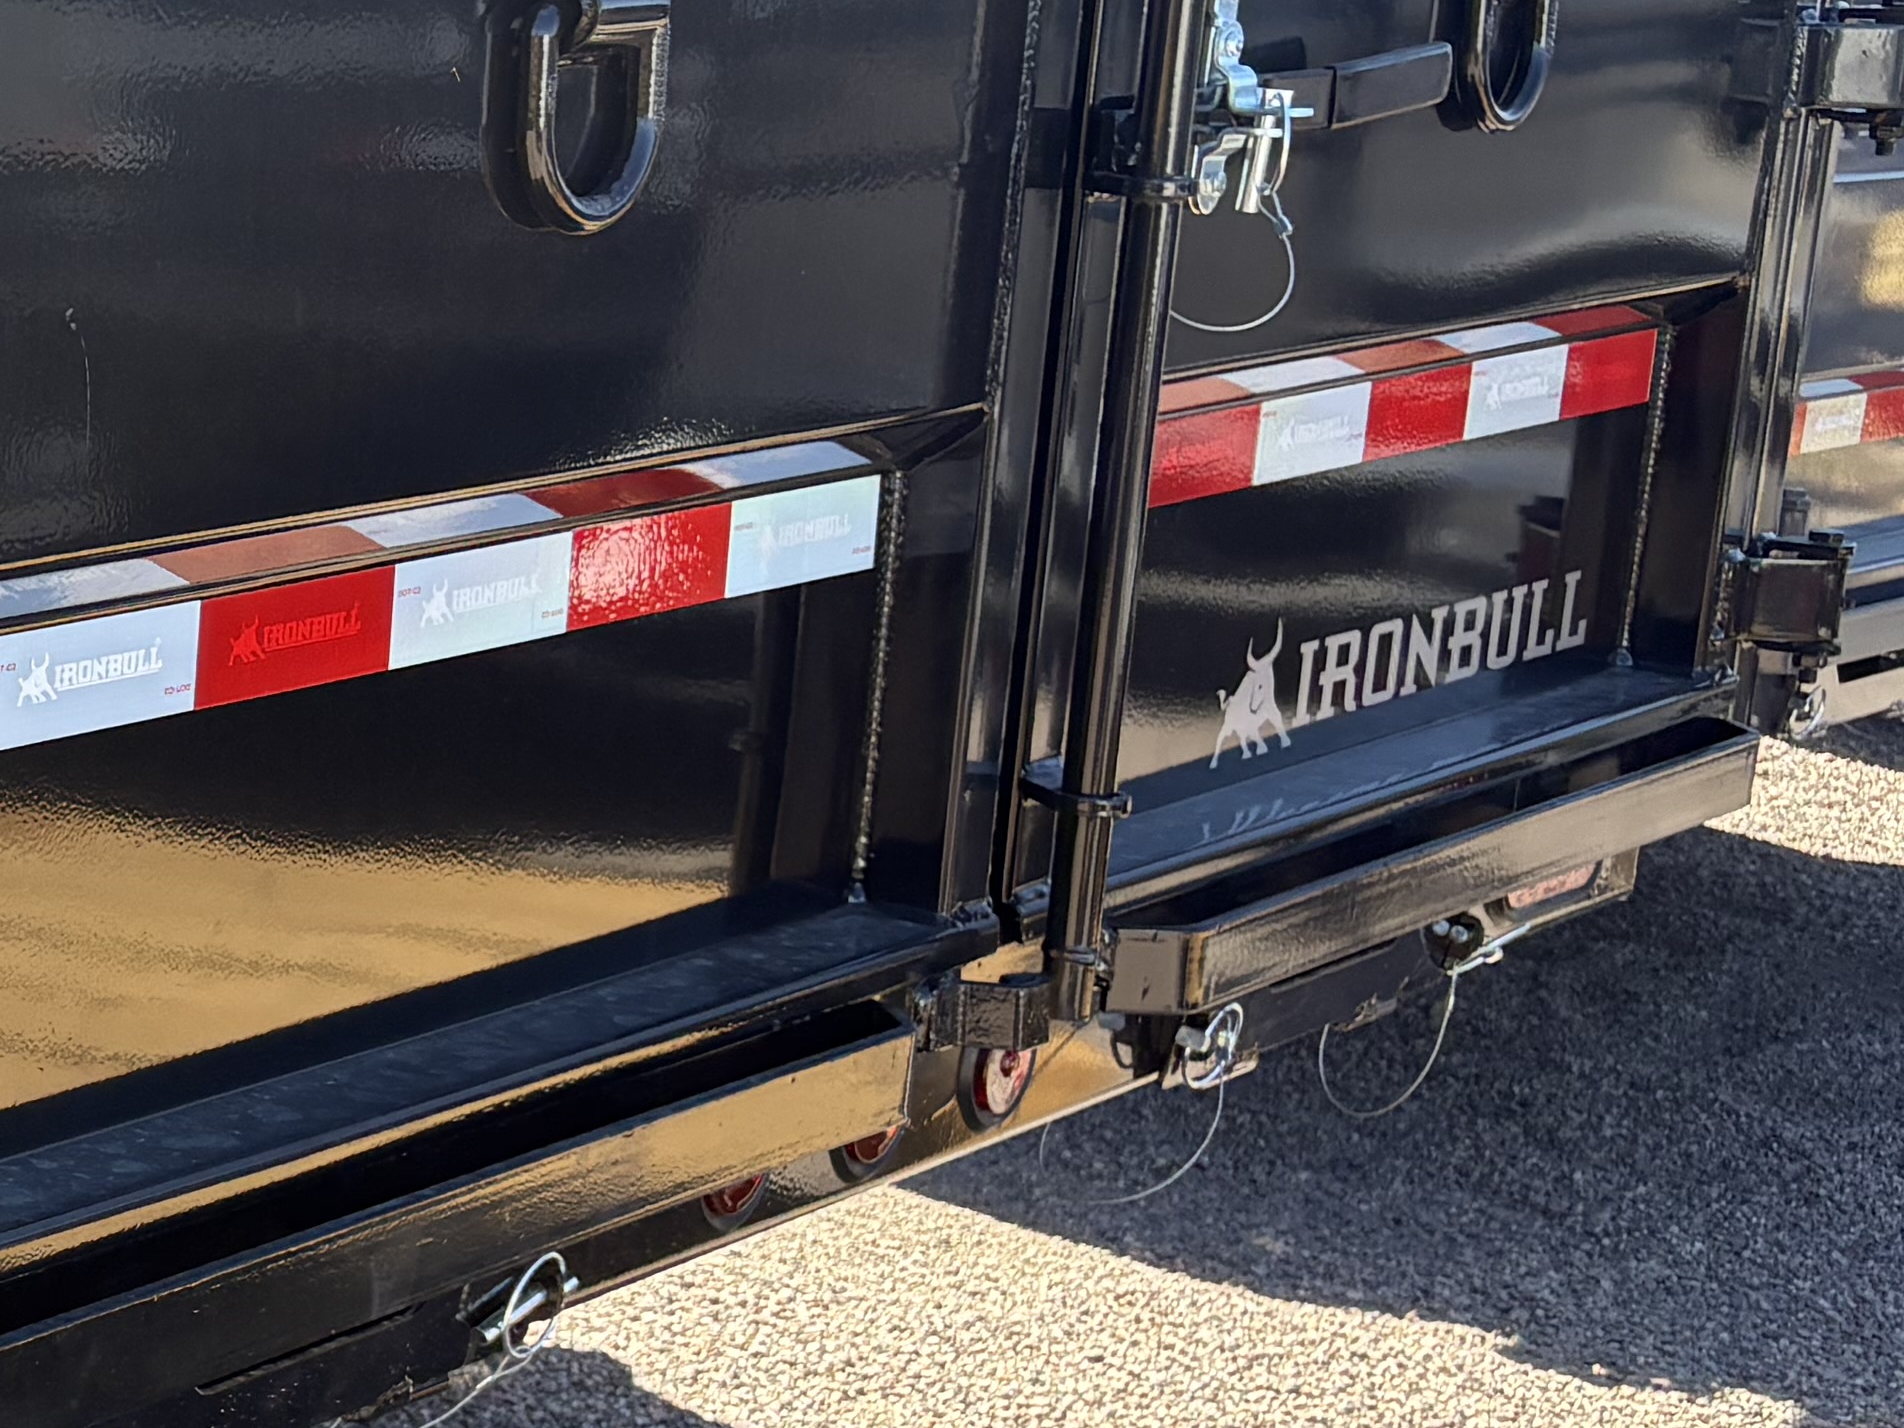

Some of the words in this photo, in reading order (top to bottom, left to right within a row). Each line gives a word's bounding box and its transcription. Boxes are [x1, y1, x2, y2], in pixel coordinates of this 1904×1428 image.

[452, 573, 542, 611] IRONBULL
[263, 610, 362, 650] IRONBULL
[1293, 570, 1588, 726] IRONBULL
[55, 646, 163, 688] IRONBULL
